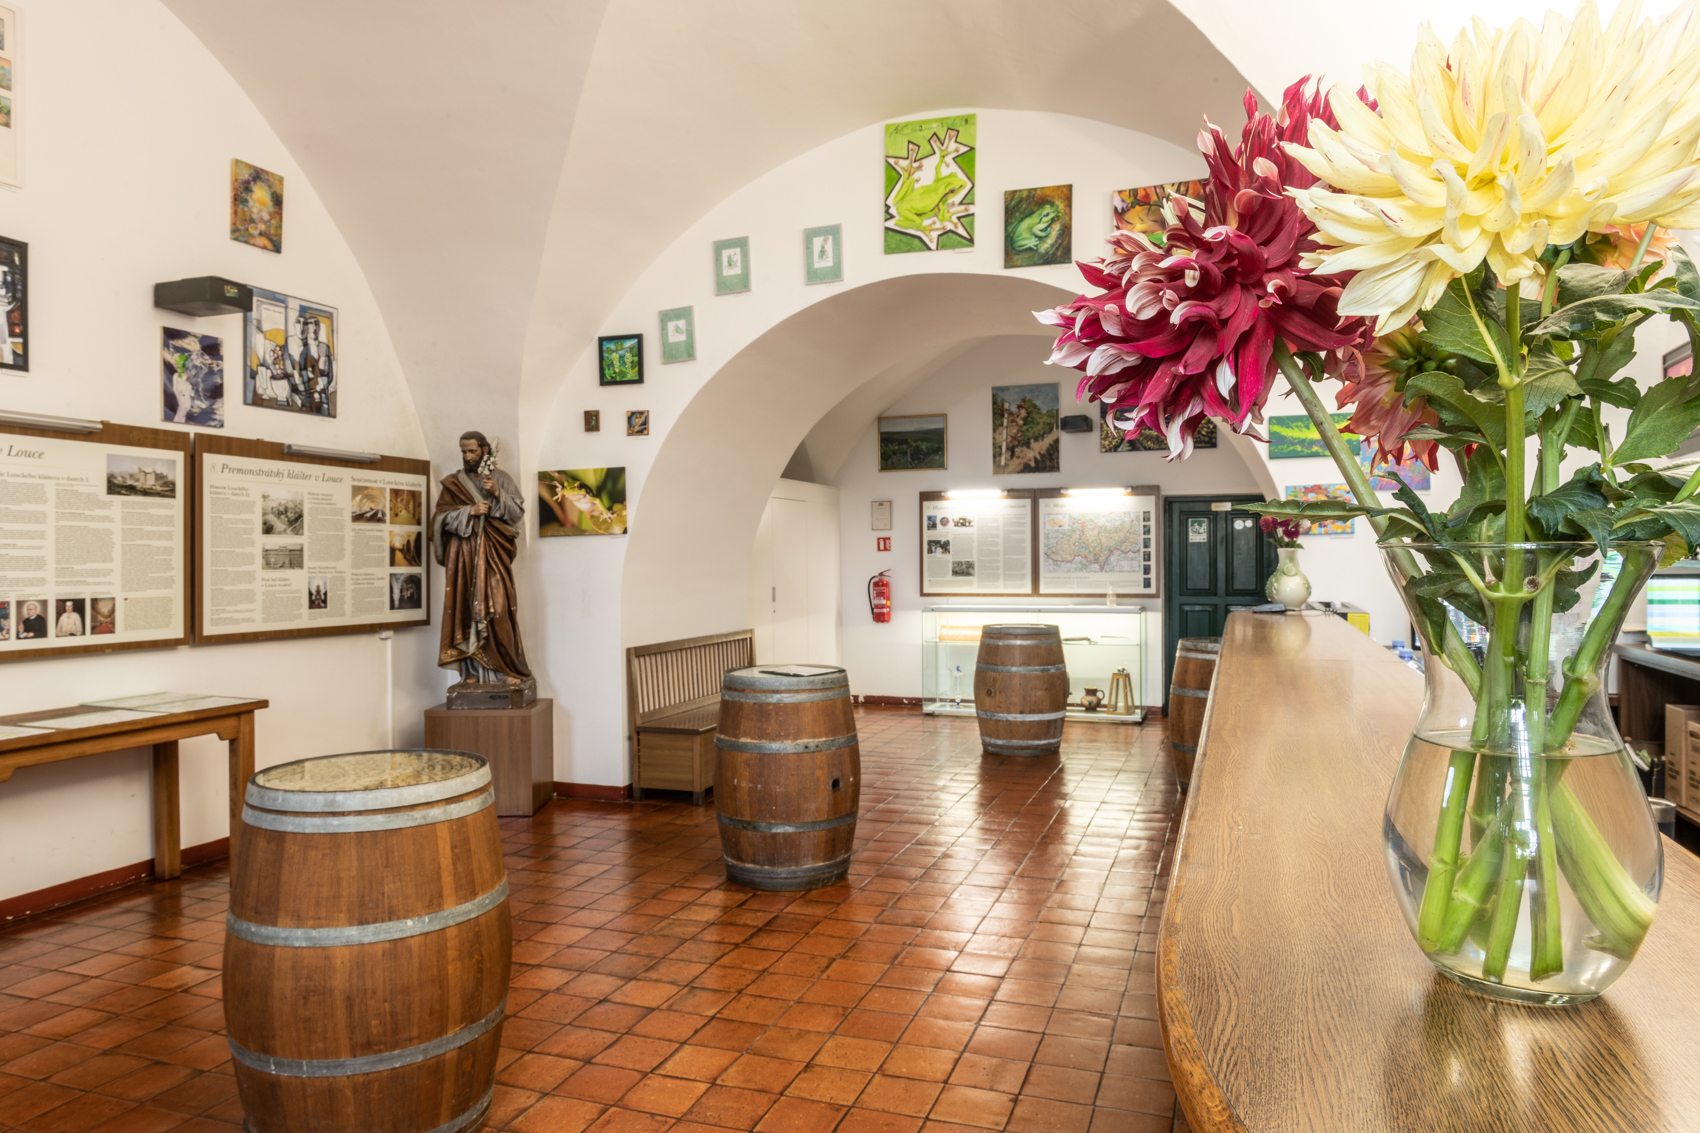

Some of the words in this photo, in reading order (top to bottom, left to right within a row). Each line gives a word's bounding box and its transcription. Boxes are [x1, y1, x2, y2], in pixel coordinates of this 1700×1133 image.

[7, 445, 45, 459] Louce
[209, 462, 219, 473] 8.
[221, 463, 285, 482] Premonstrátský
[287, 468, 312, 480] klášter
[313, 474, 320, 482] v
[321, 473, 344, 484] Louce
[350, 475, 378, 484] Současnost
[382, 478, 405, 487] Louckém
